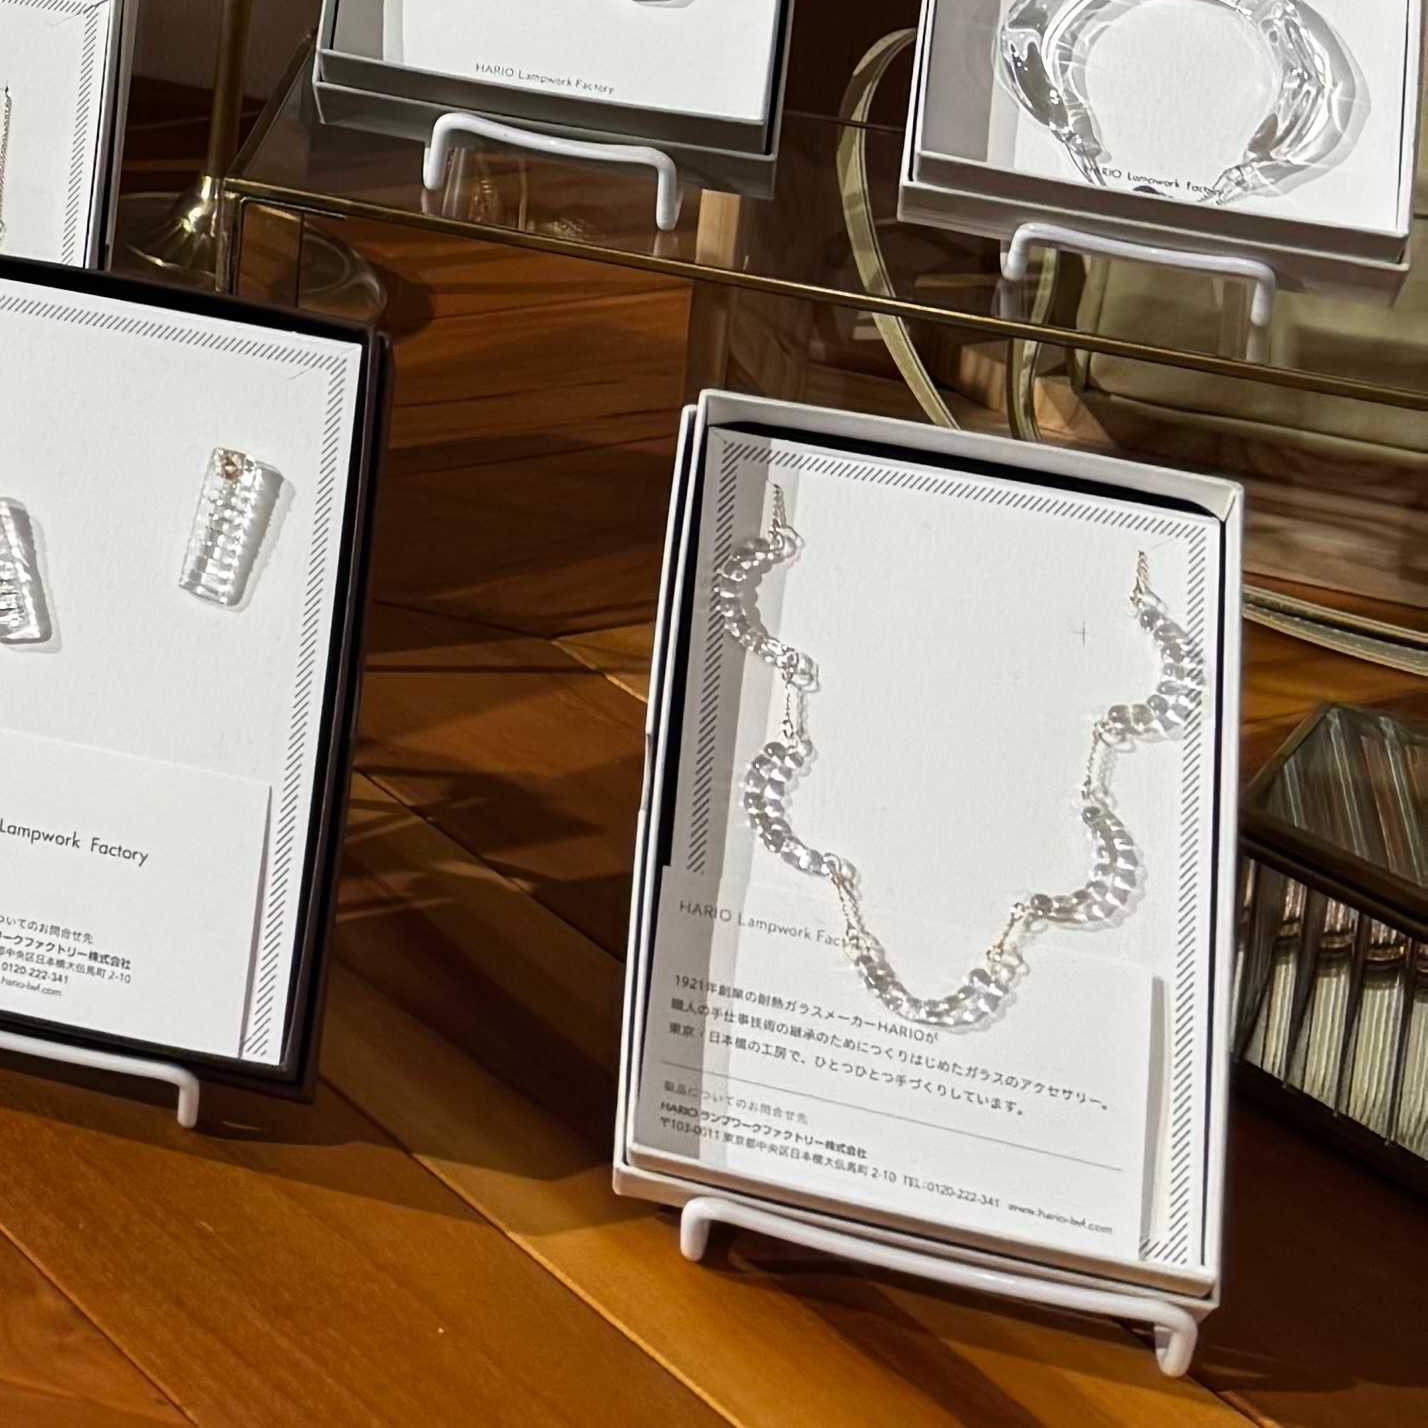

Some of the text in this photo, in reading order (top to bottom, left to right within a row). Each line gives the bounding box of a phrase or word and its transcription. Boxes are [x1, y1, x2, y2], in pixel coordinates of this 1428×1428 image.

[475, 62, 514, 78] HARIO
[518, 69, 572, 87] Lampwork
[0, 817, 81, 849] Lampwork
[90, 837, 149, 867] Factory
[679, 900, 733, 923] HARIO
[737, 910, 812, 942] Lampwork
[107, 969, 132, 985] 2-10
